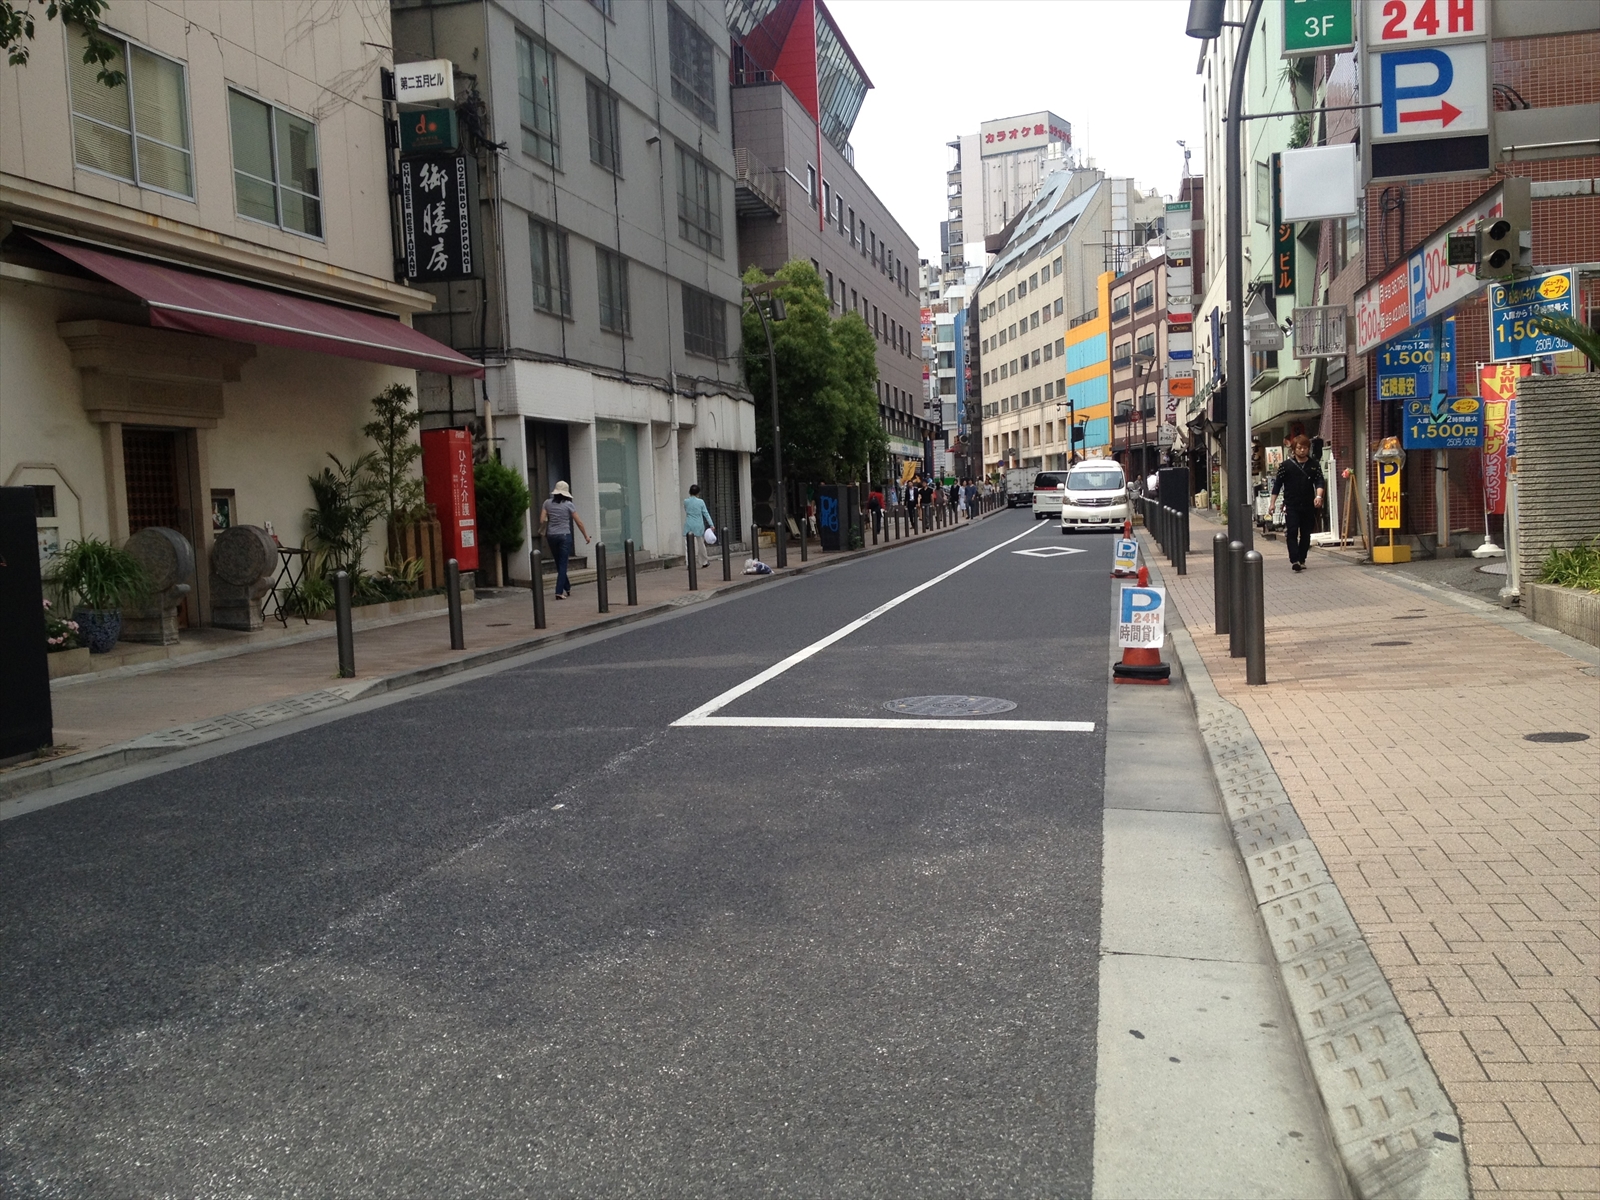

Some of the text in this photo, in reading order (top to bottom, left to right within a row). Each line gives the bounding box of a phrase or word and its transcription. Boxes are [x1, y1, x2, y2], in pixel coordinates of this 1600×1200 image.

[1304, 15, 1335, 38] 3F
[1382, 0, 1474, 40] 24H
[400, 72, 444, 91] 第二五月ビル
[1381, 48, 1453, 134] P
[402, 163, 417, 277] CHINESE RESTAURANT
[1411, 254, 1424, 319] P
[1542, 285, 1568, 297] オープン
[1496, 290, 1505, 304] P
[1411, 403, 1419, 412] P
[1411, 424, 1478, 438] 1,500円
[1379, 461, 1399, 484] P
[1379, 505, 1399, 520] OPEN
[1117, 541, 1136, 557] P
[1121, 588, 1162, 624] P
[1134, 613, 1160, 624] 24H
[1119, 624, 1161, 643] 時間貸し
